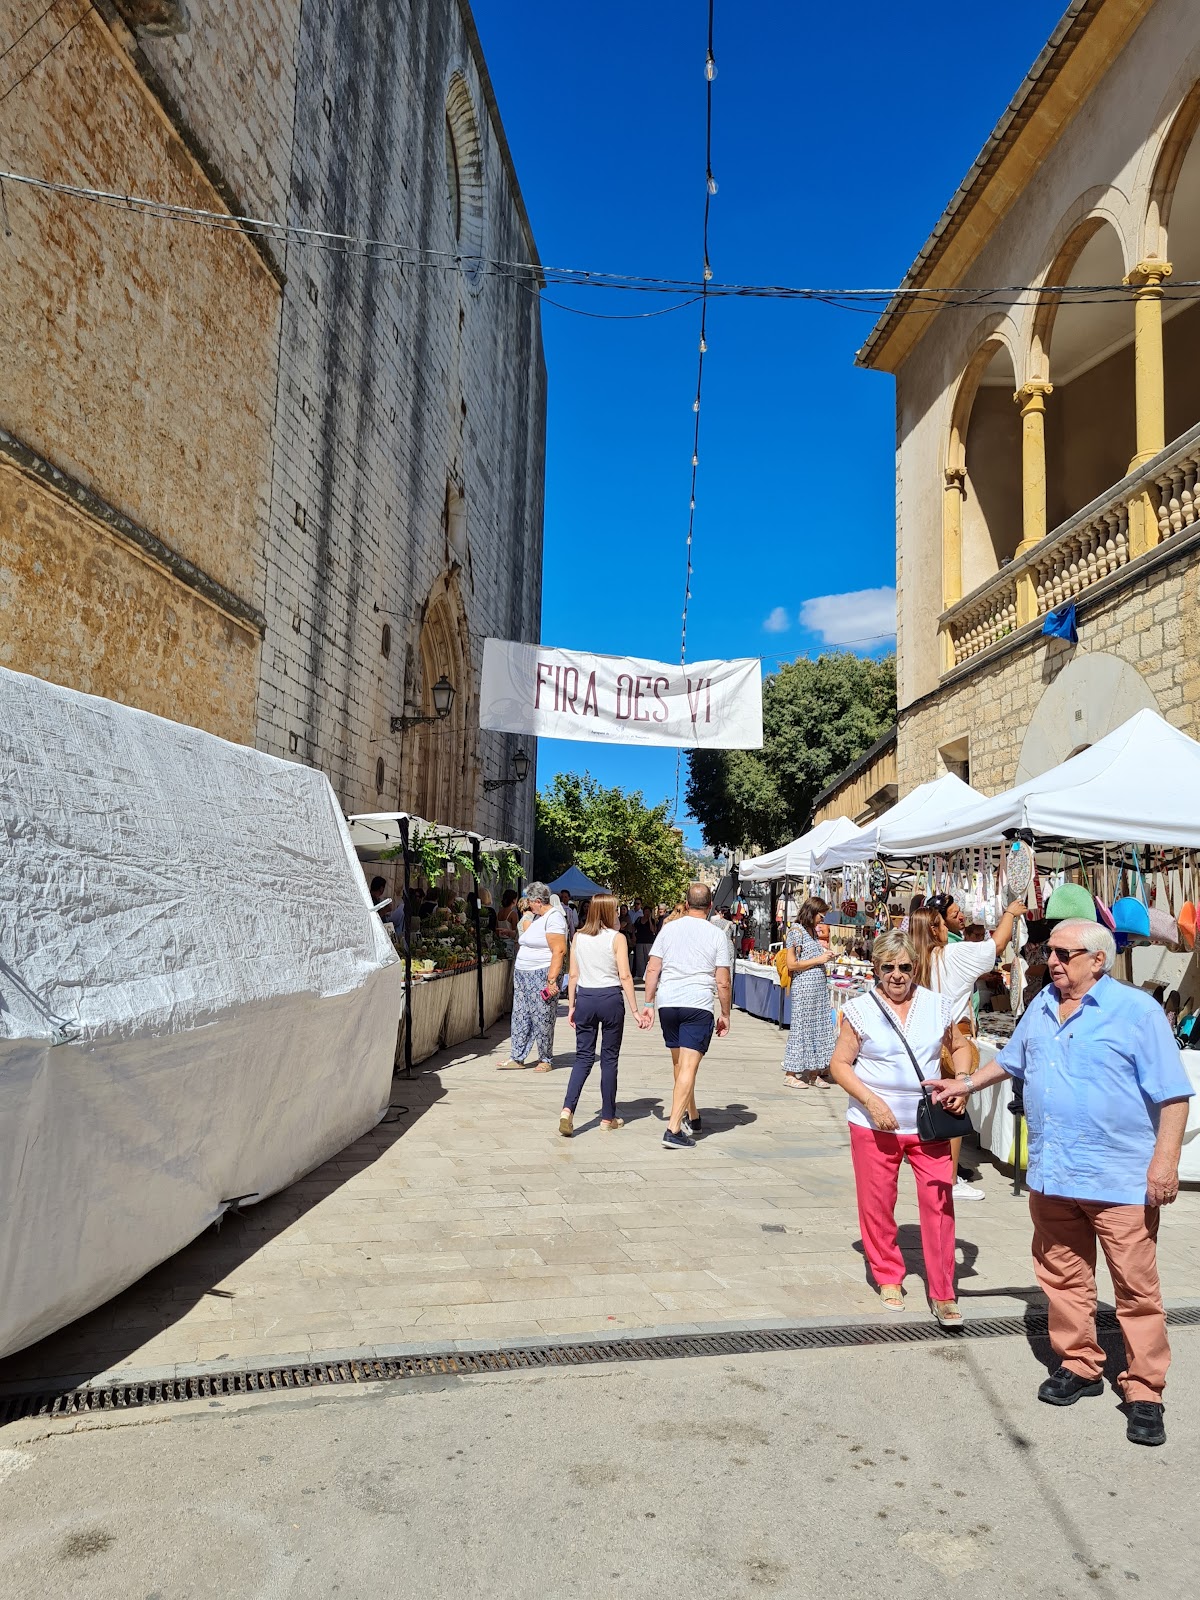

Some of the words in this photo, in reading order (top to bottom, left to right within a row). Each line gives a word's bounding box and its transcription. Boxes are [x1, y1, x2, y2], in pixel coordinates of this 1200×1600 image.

[534, 662, 600, 717] FIRA
[616, 673, 670, 723] DES
[687, 678, 712, 723] VI
